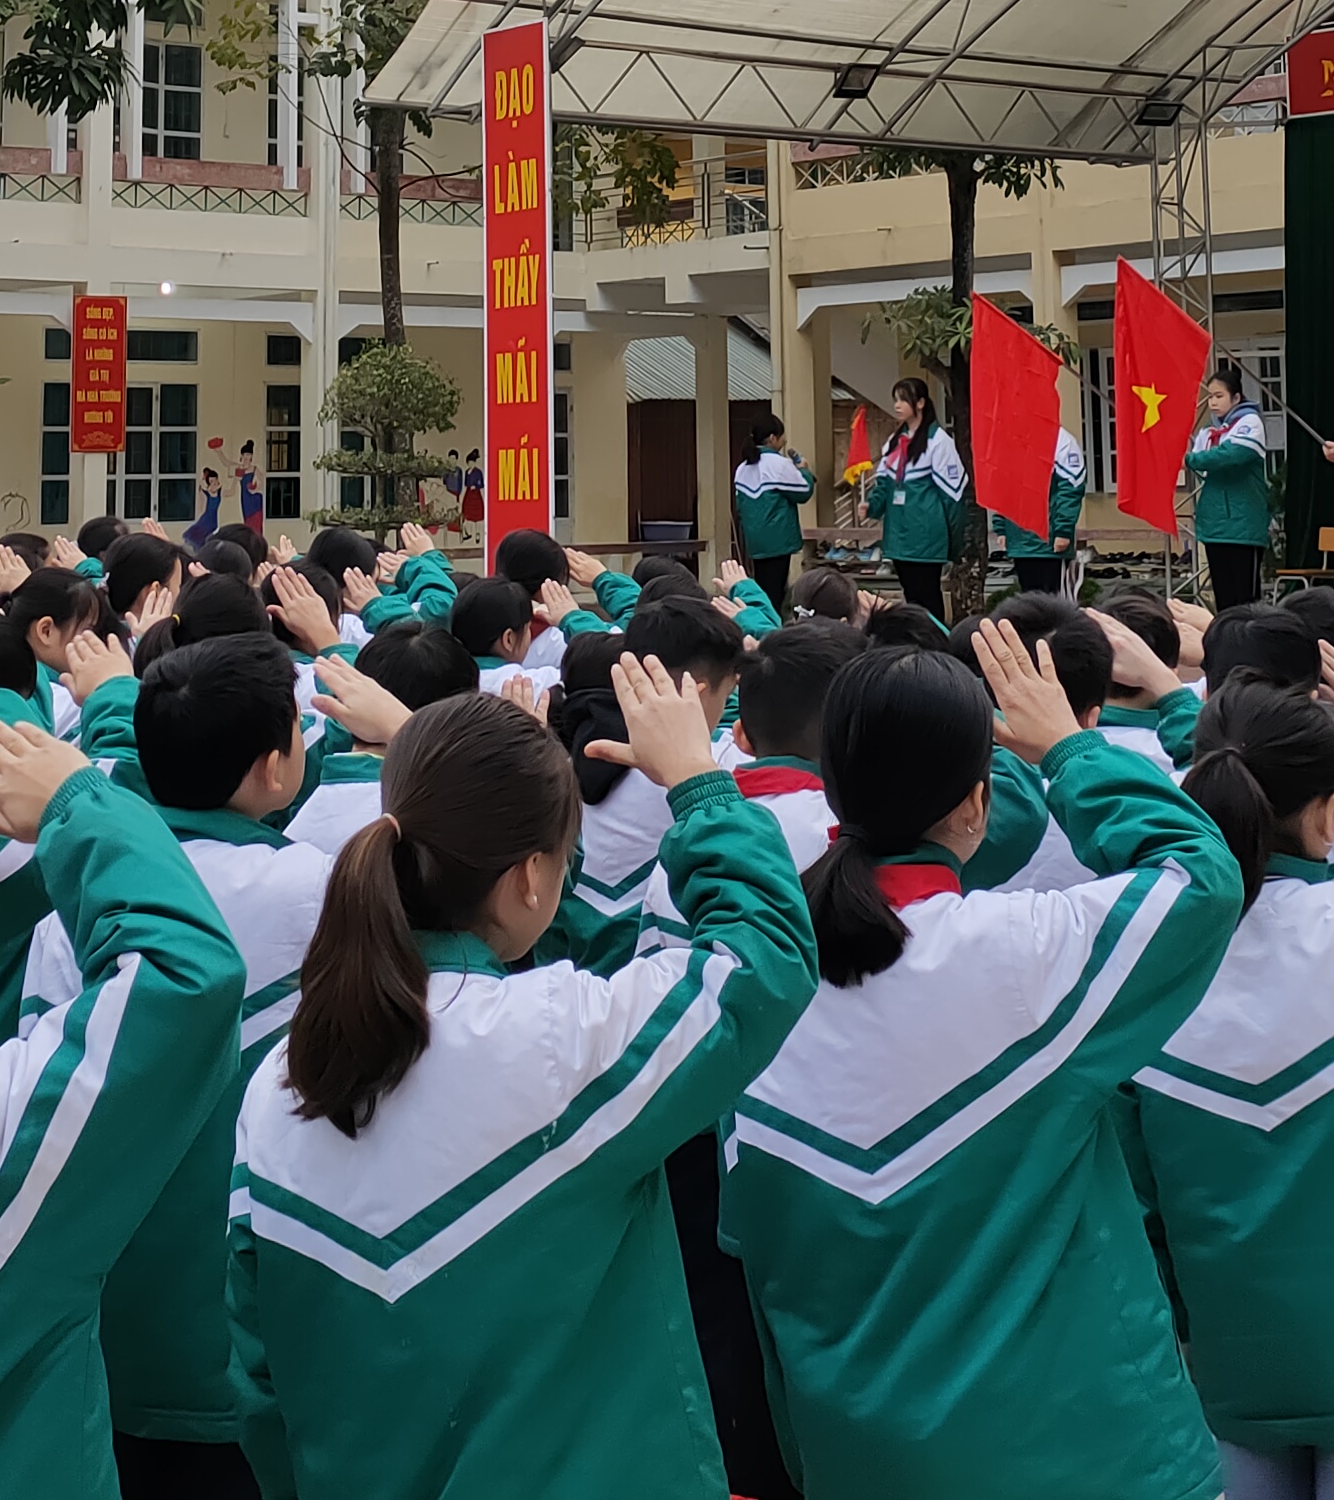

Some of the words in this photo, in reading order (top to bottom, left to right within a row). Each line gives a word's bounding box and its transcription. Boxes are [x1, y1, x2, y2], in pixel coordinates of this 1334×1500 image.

[494, 64, 534, 128] ĐẠO
[494, 152, 538, 214] LÀM
[492, 238, 540, 309] THẦY
[495, 336, 538, 404] MÃI
[497, 433, 540, 501] MÃI
